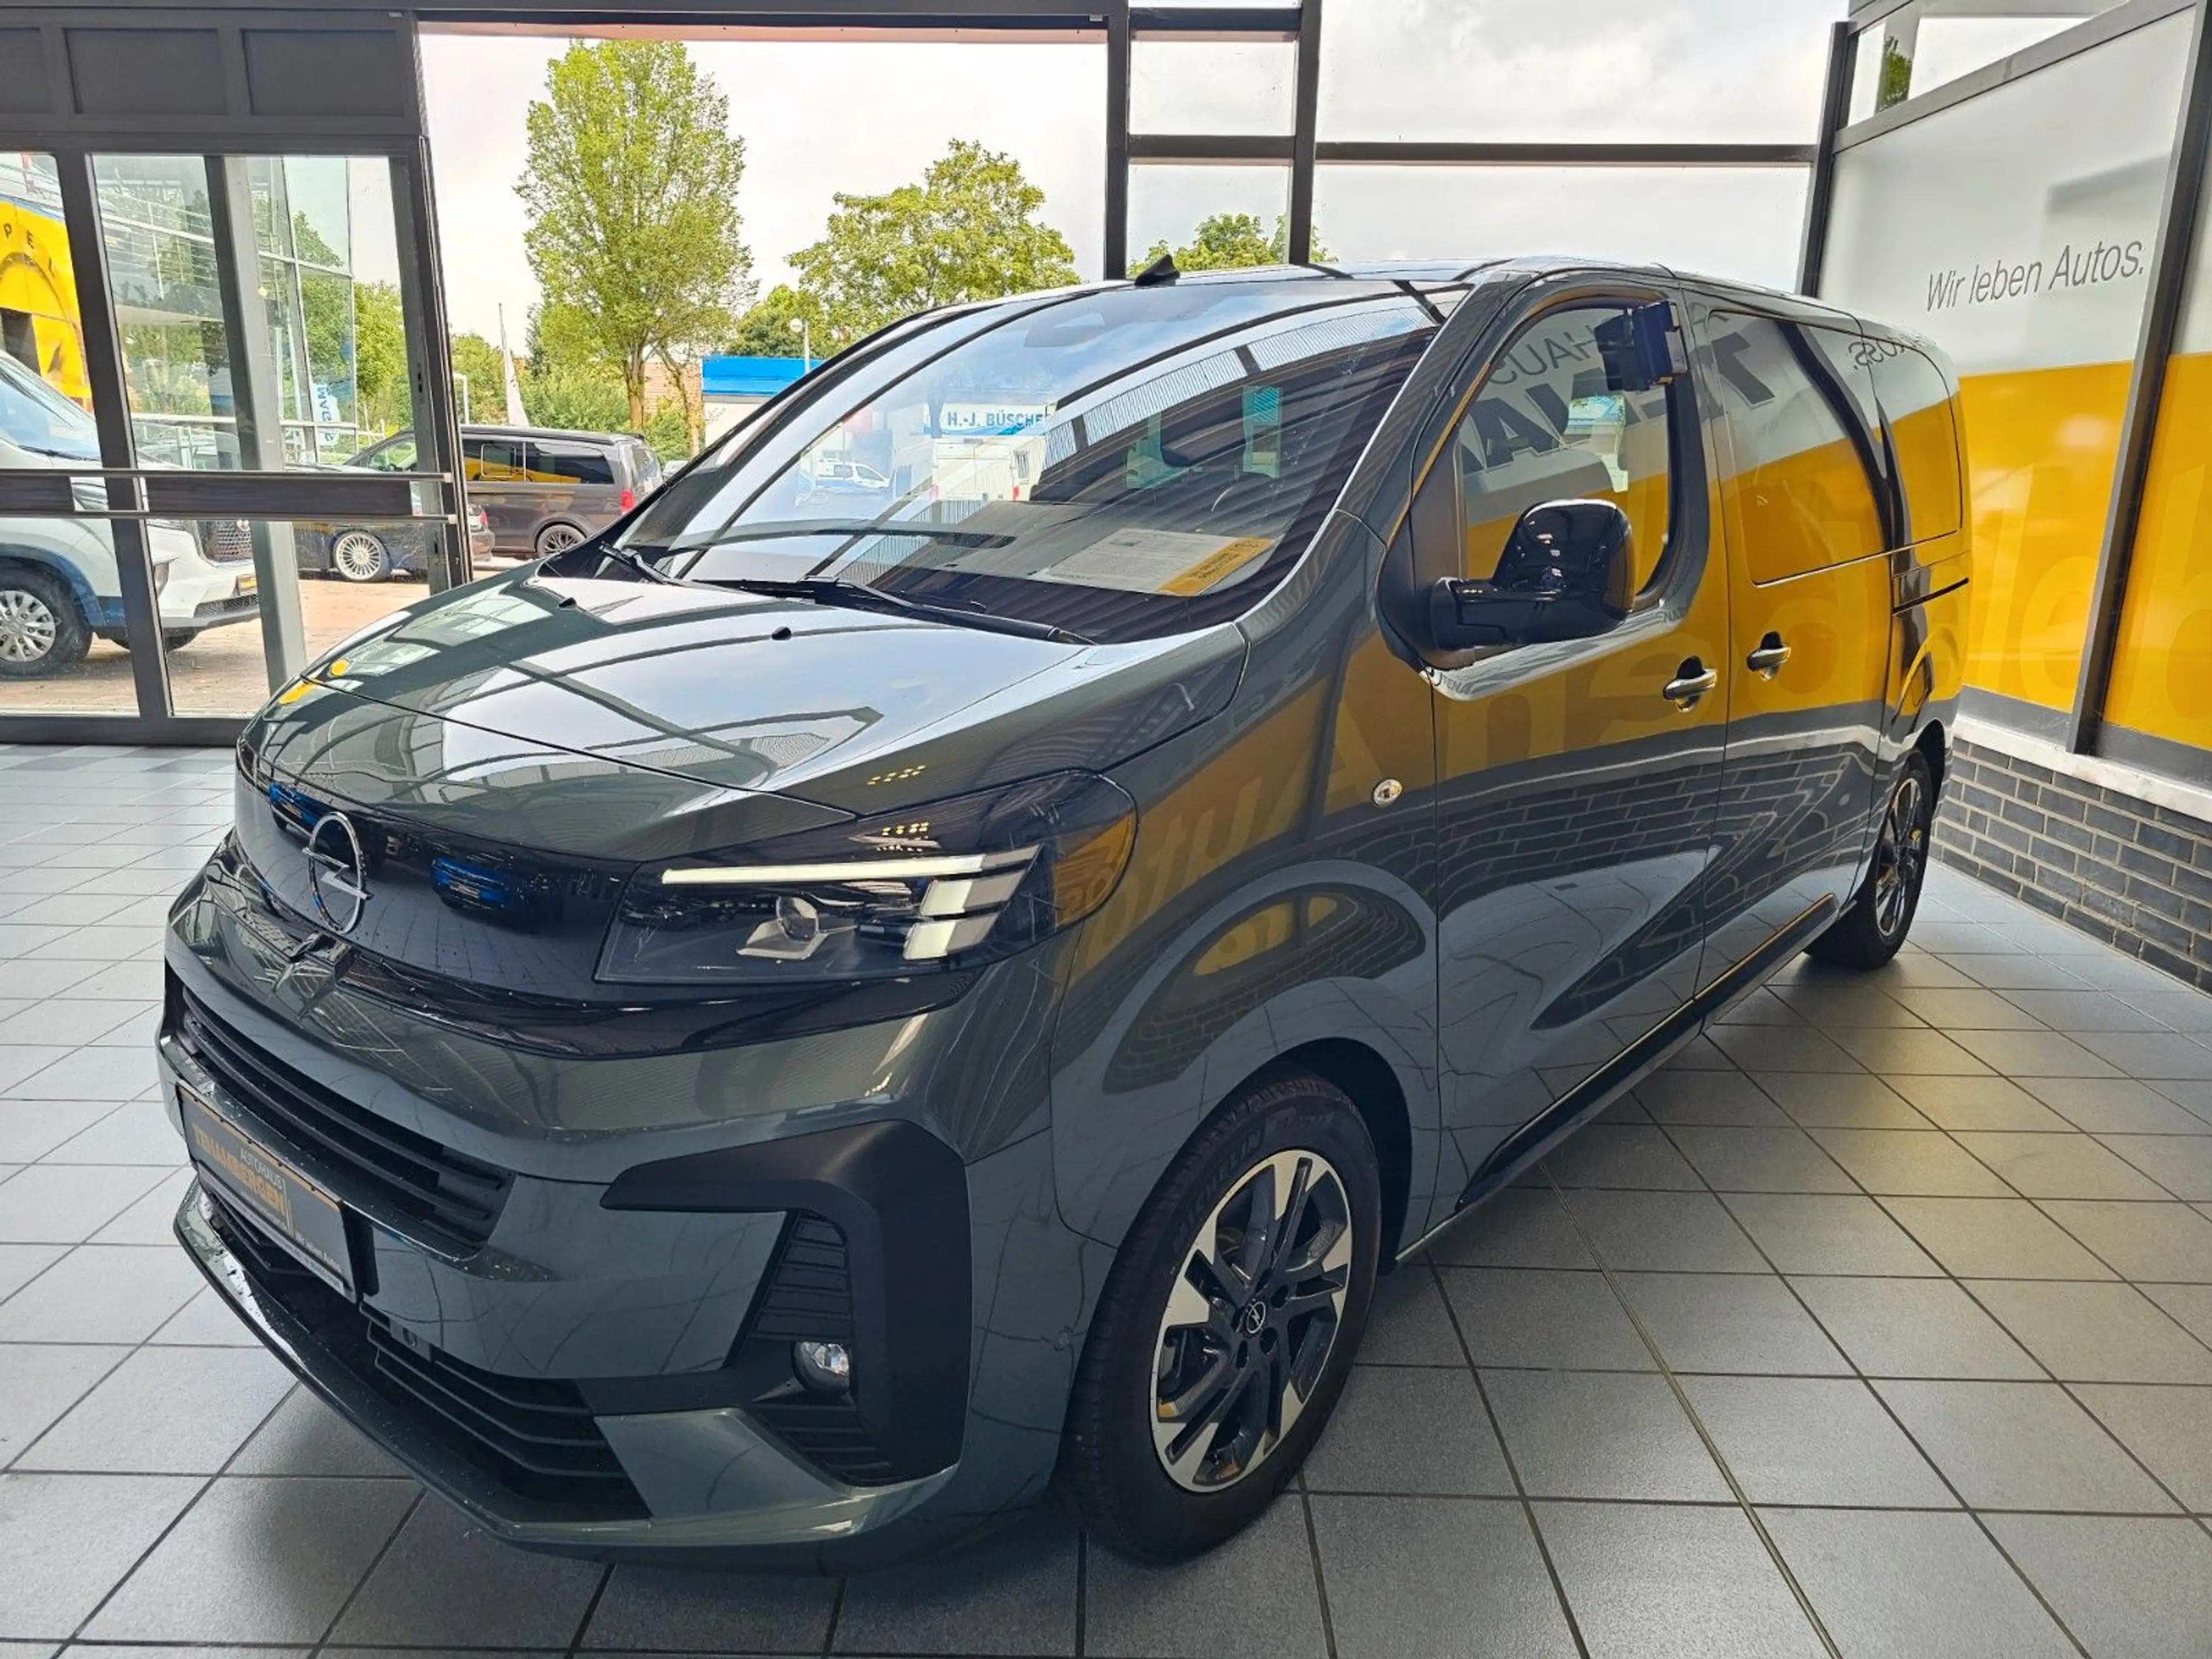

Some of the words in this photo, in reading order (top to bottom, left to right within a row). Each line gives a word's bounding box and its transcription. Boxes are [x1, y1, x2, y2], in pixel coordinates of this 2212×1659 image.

[1927, 270, 1965, 312] Wir
[1968, 260, 2043, 305] leben
[2048, 241, 2143, 290] Autos.
[948, 411, 980, 427] H.-J.
[986, 409, 1050, 427] BÜSCHE
